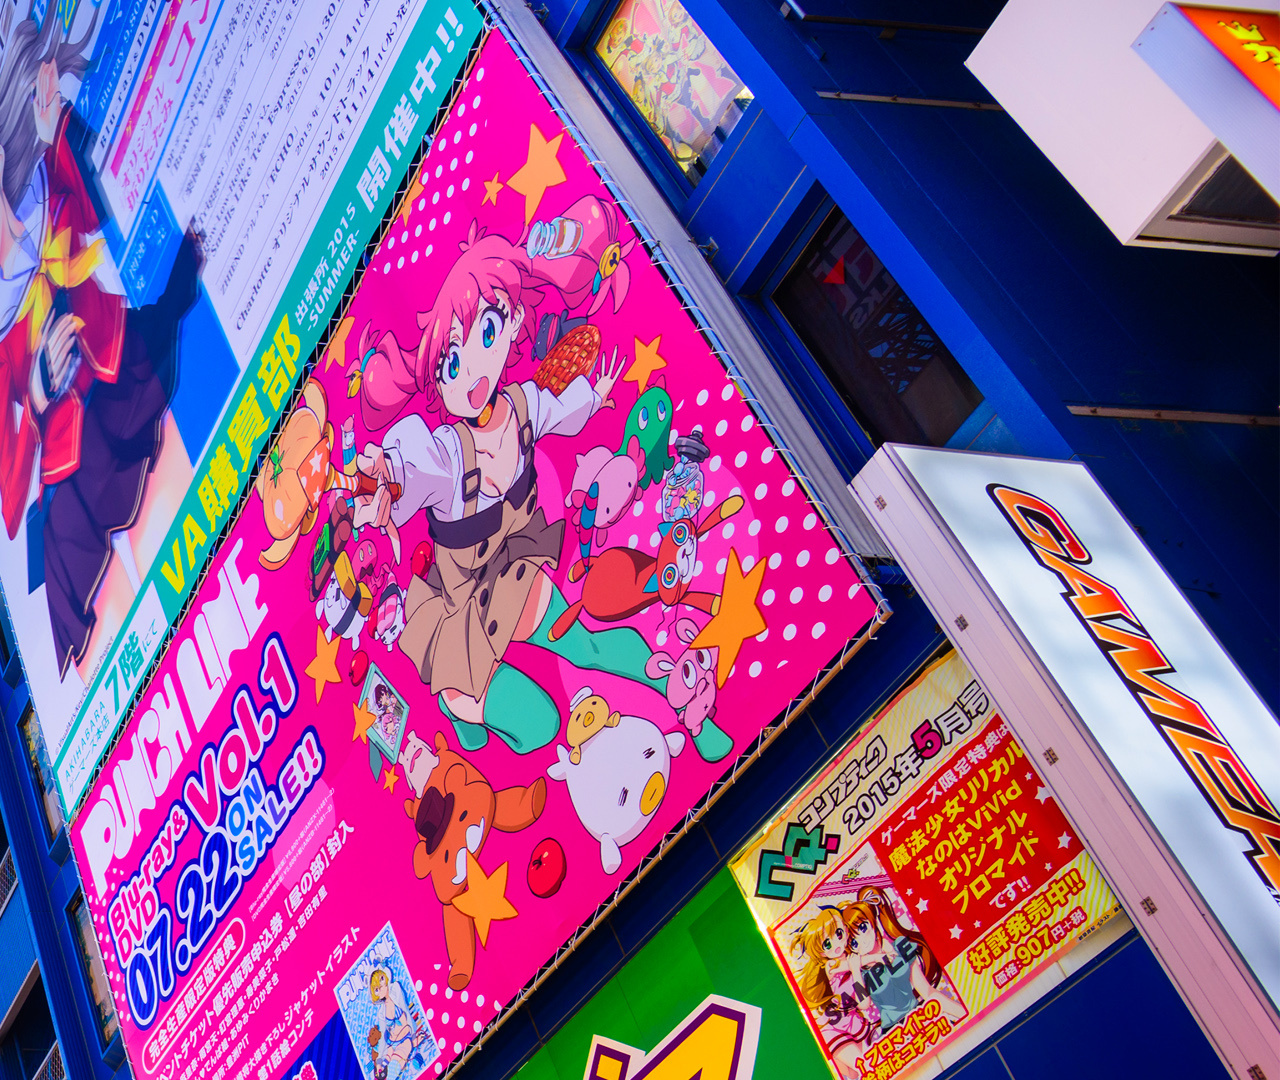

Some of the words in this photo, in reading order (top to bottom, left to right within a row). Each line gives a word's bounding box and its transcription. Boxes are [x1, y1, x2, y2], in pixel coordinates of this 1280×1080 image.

[63, 701, 106, 783] AKIHABARA
[842, 680, 990, 835] 2015年5月号
[80, 672, 192, 901] PUNCH
[888, 740, 1026, 873] 魔法少女リリカル
[938, 808, 1028, 892] オリジナル
[951, 832, 1041, 915] ブロマイド
[114, 889, 160, 968] DVD
[824, 936, 922, 1026] SAMPLE
